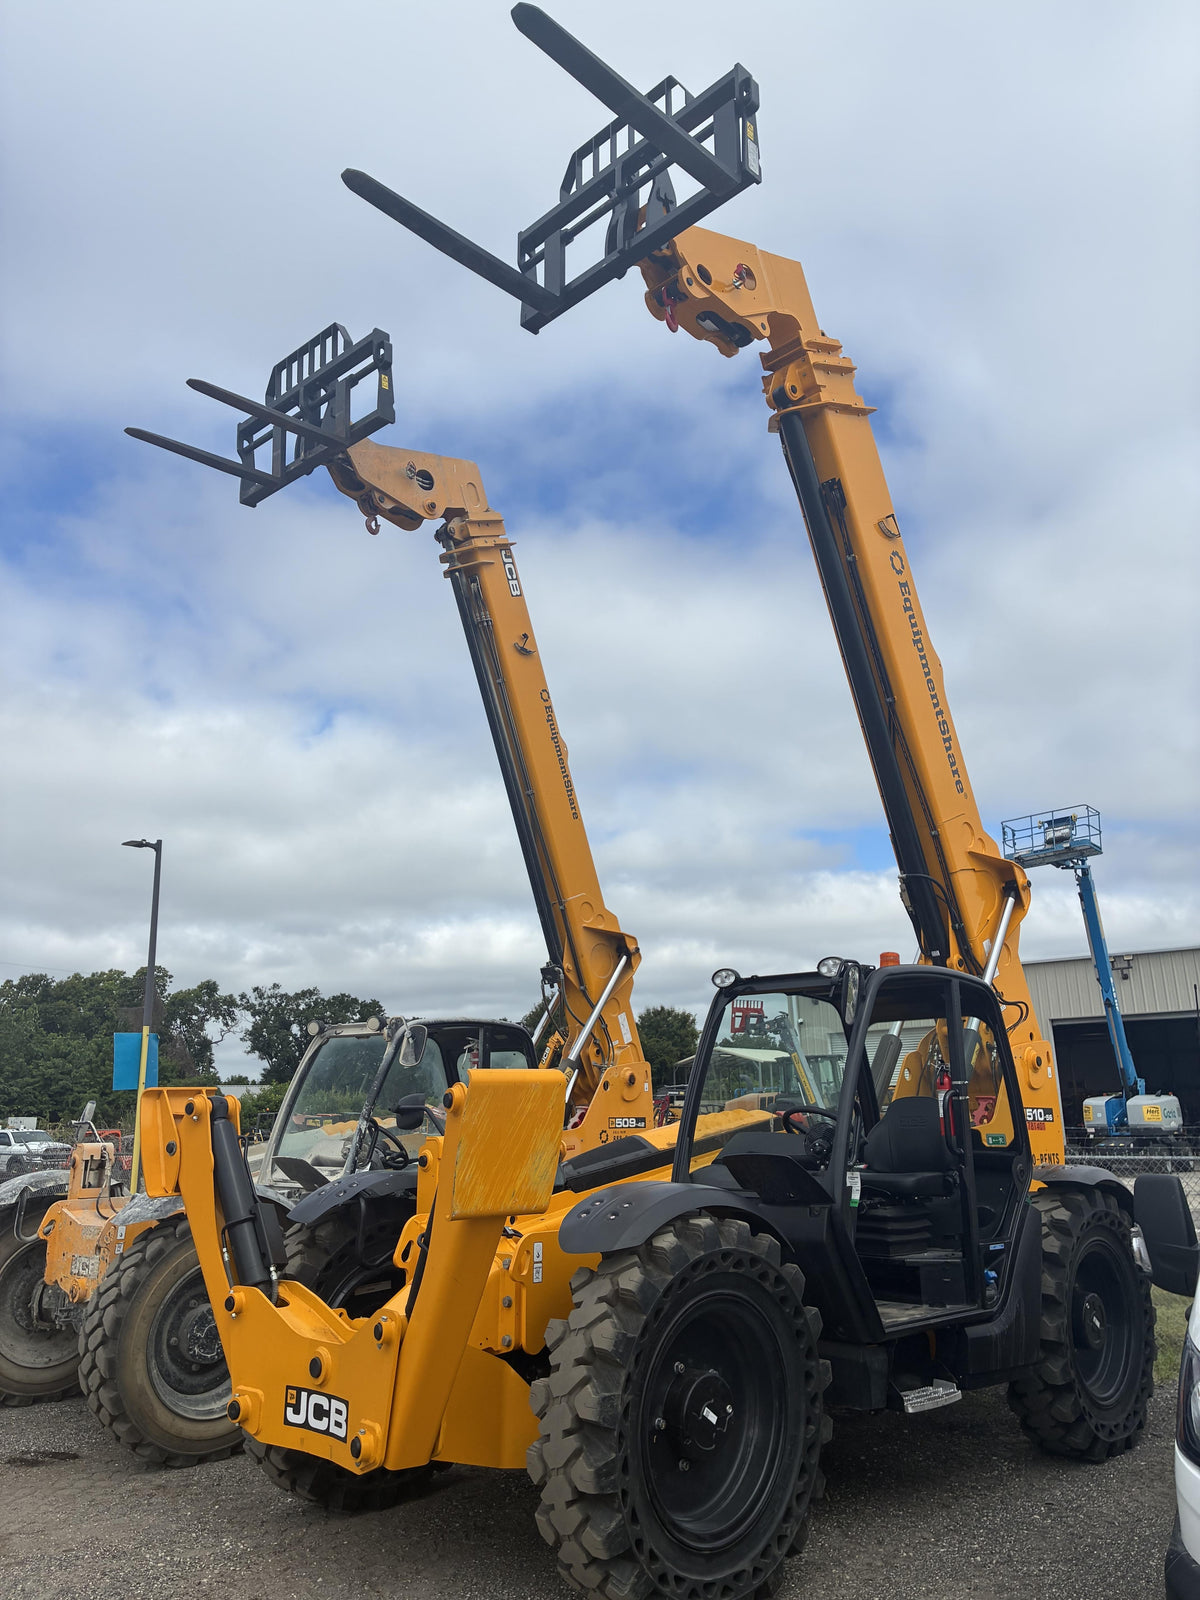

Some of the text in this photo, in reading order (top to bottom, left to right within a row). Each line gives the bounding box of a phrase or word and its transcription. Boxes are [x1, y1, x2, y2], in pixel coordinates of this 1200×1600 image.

[500, 549, 521, 596] JCB
[898, 580, 965, 794] EquipmentShare
[544, 704, 578, 820] EquipmentShare
[286, 1391, 348, 1438] JCB
